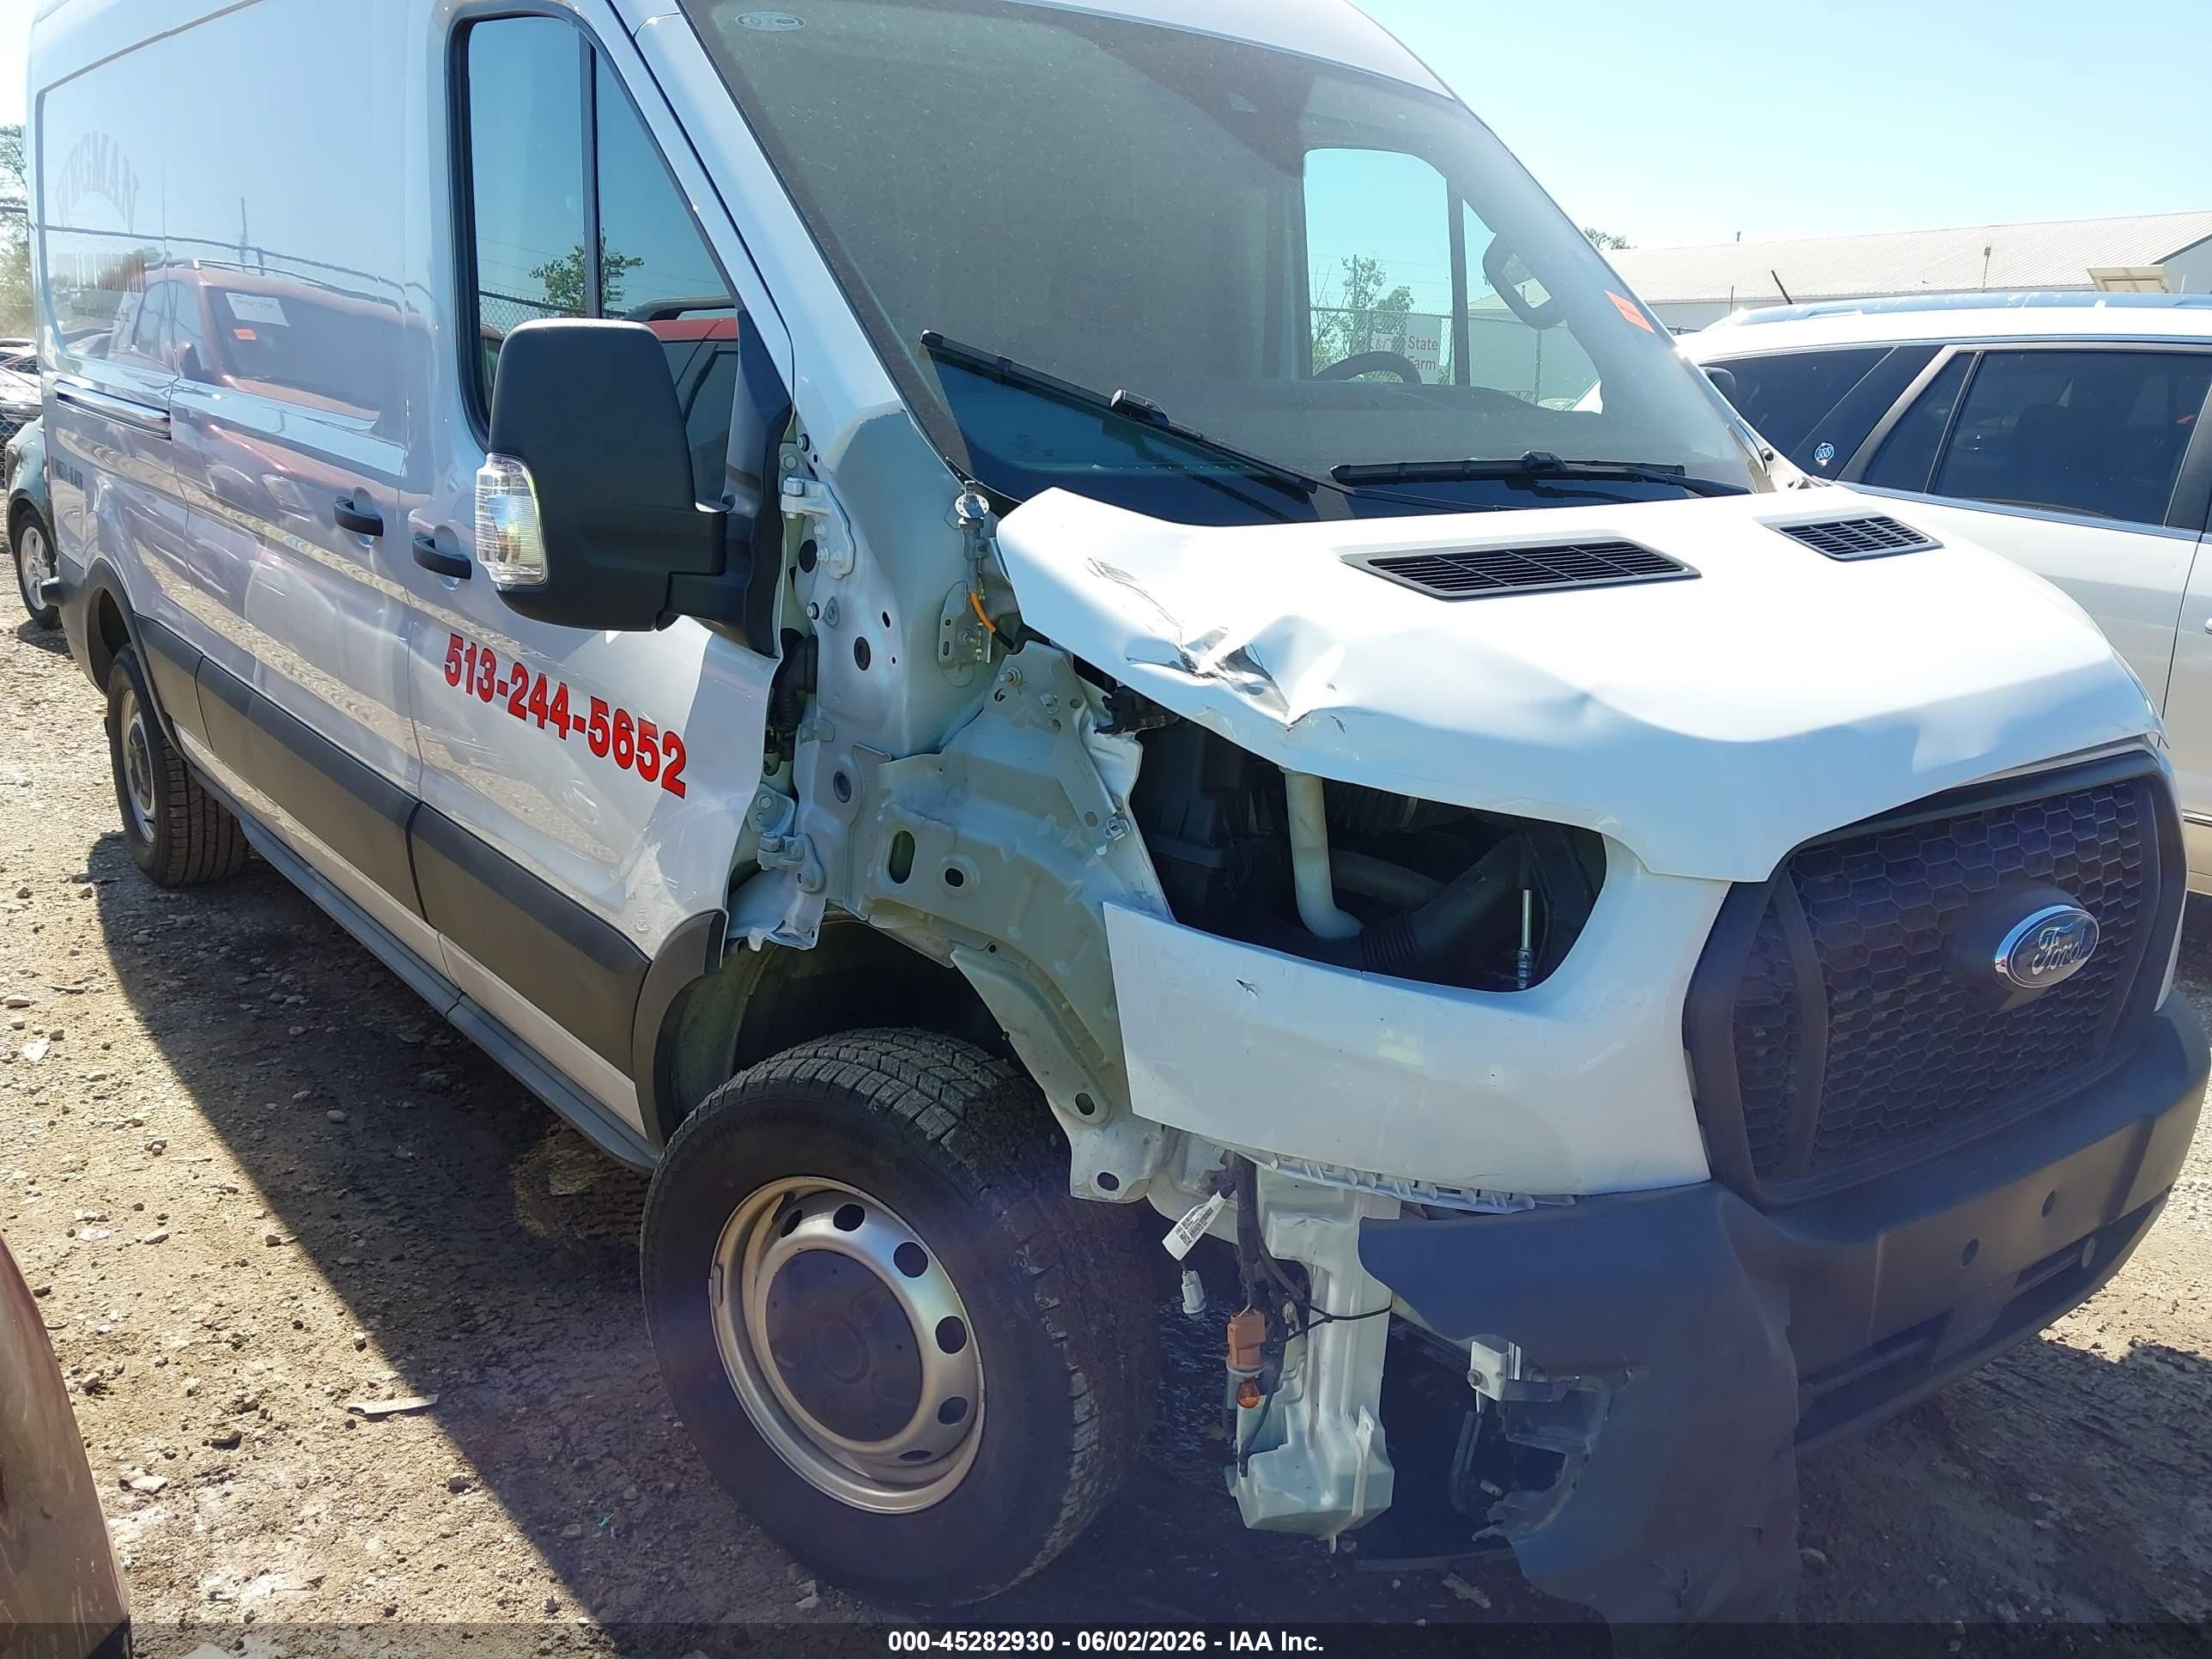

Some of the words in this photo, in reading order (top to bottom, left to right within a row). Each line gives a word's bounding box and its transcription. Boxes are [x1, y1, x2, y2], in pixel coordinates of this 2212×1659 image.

[1407, 335, 1438, 350] State
[444, 633, 686, 799] 513-244-5652
[2031, 923, 2086, 975] Ford
